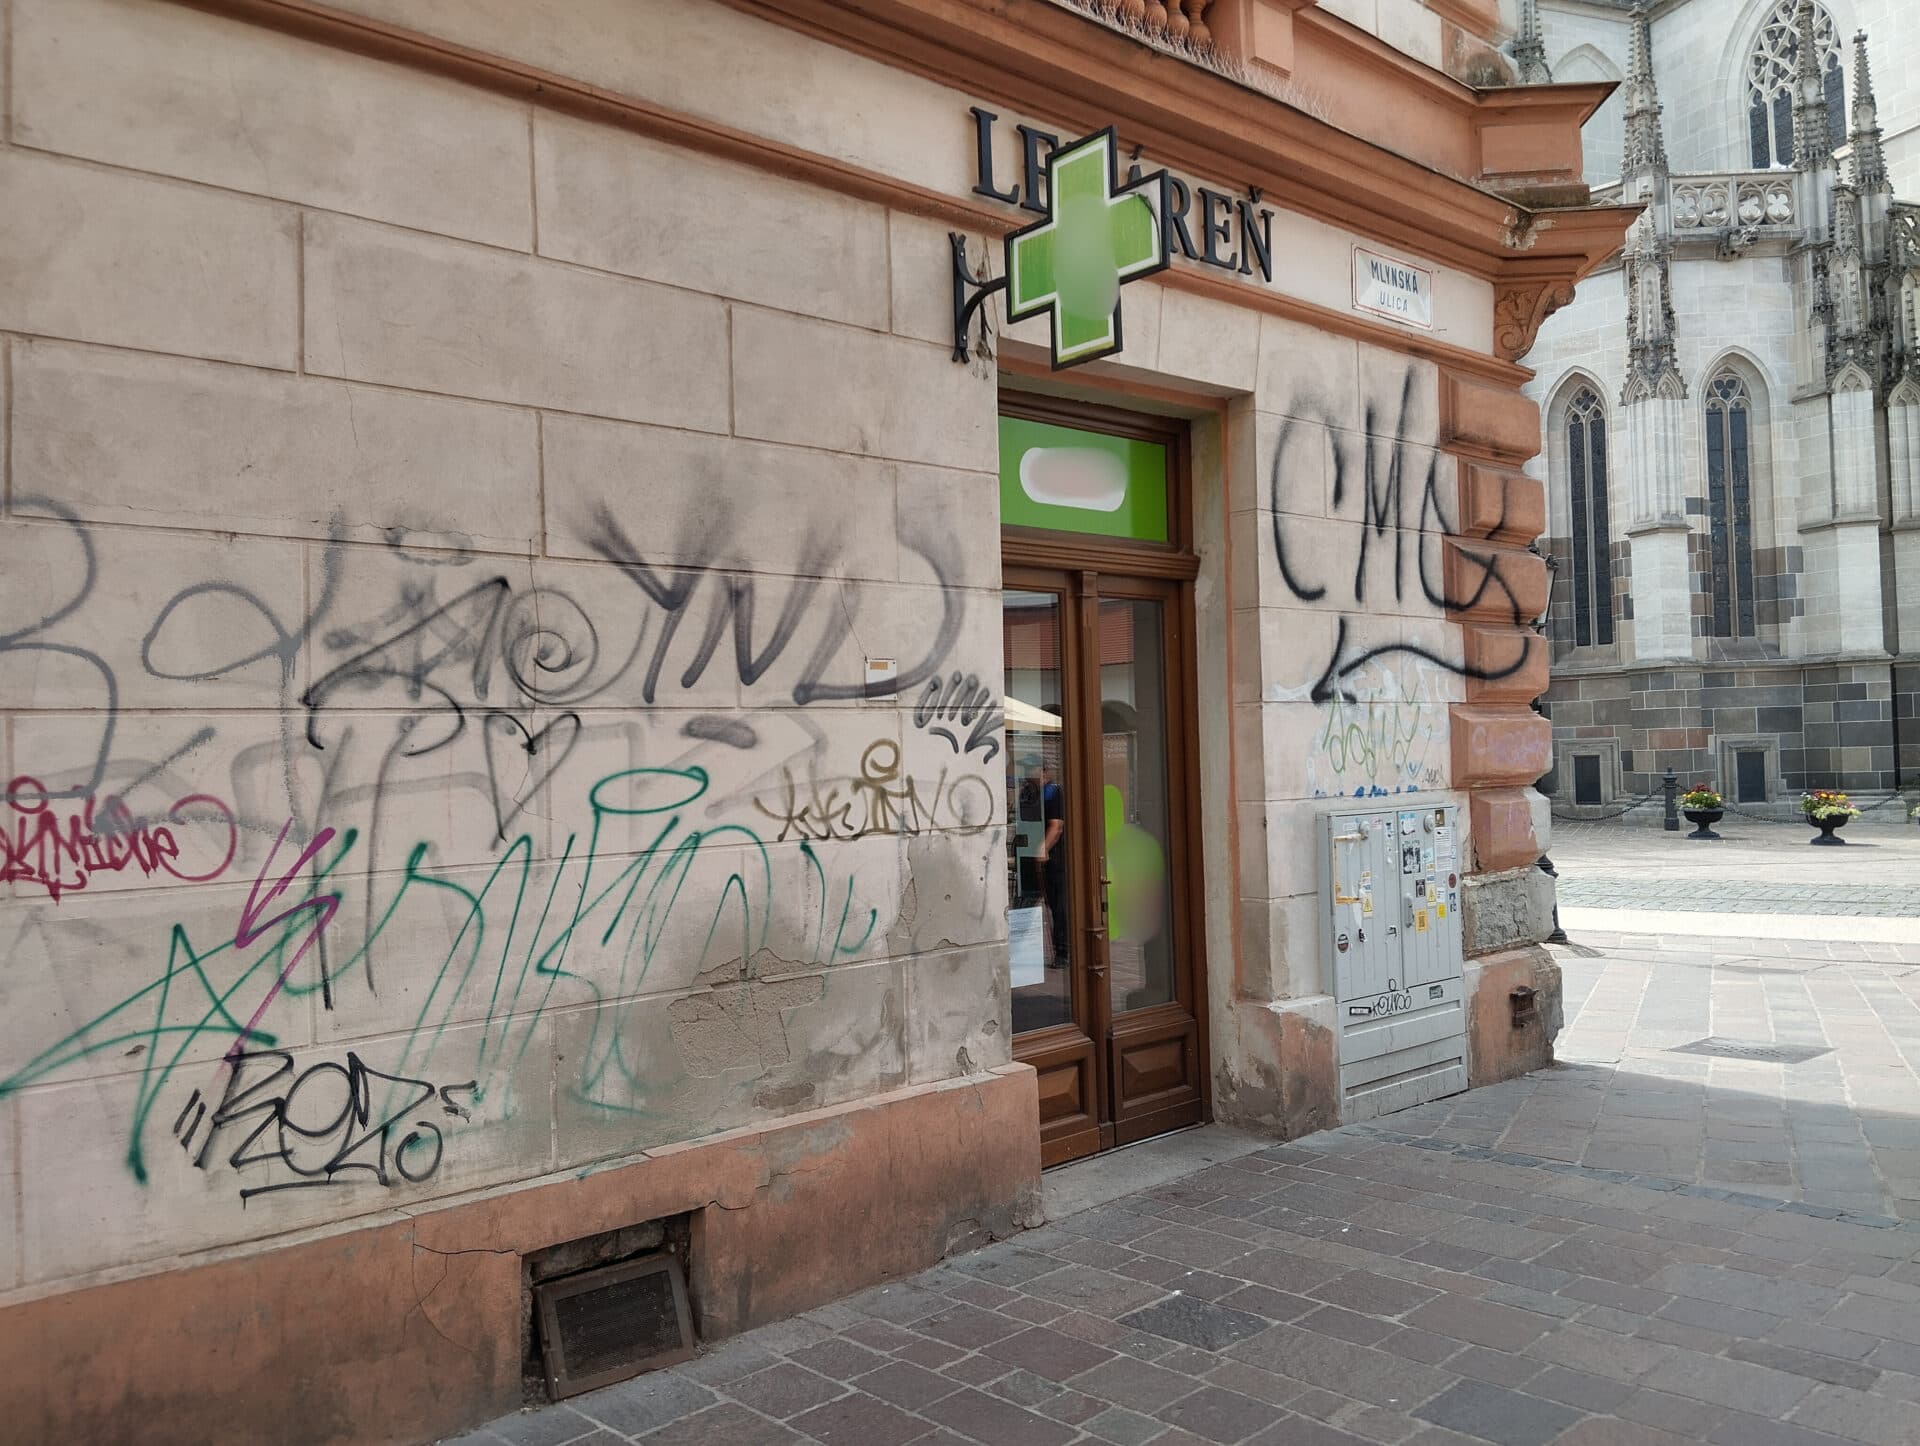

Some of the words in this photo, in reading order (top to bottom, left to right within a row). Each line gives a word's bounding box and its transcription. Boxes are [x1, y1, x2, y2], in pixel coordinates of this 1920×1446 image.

[969, 106, 1275, 283] LEREŇ
[1370, 260, 1419, 294] MLYNSKÁ
[1379, 291, 1408, 313] ULICA
